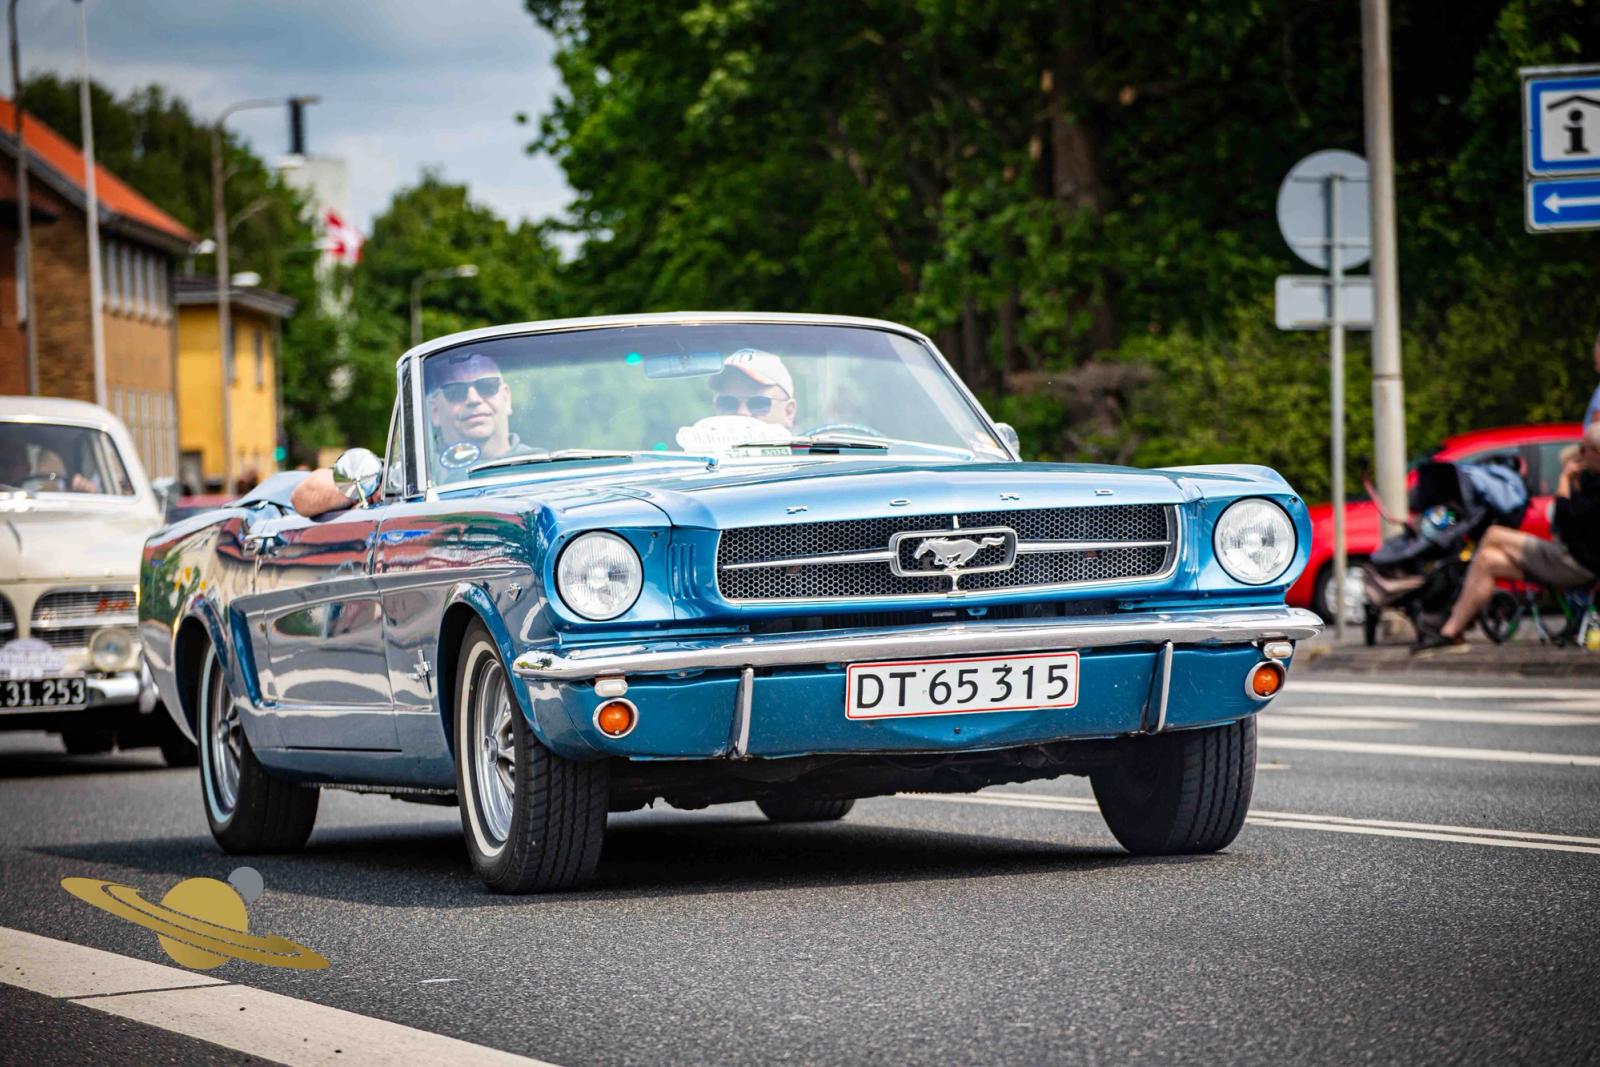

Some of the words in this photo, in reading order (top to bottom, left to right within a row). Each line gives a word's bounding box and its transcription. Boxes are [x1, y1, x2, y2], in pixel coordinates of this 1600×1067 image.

[856, 671, 917, 709] DT
[928, 668, 979, 705] 65
[990, 663, 1069, 703] 315
